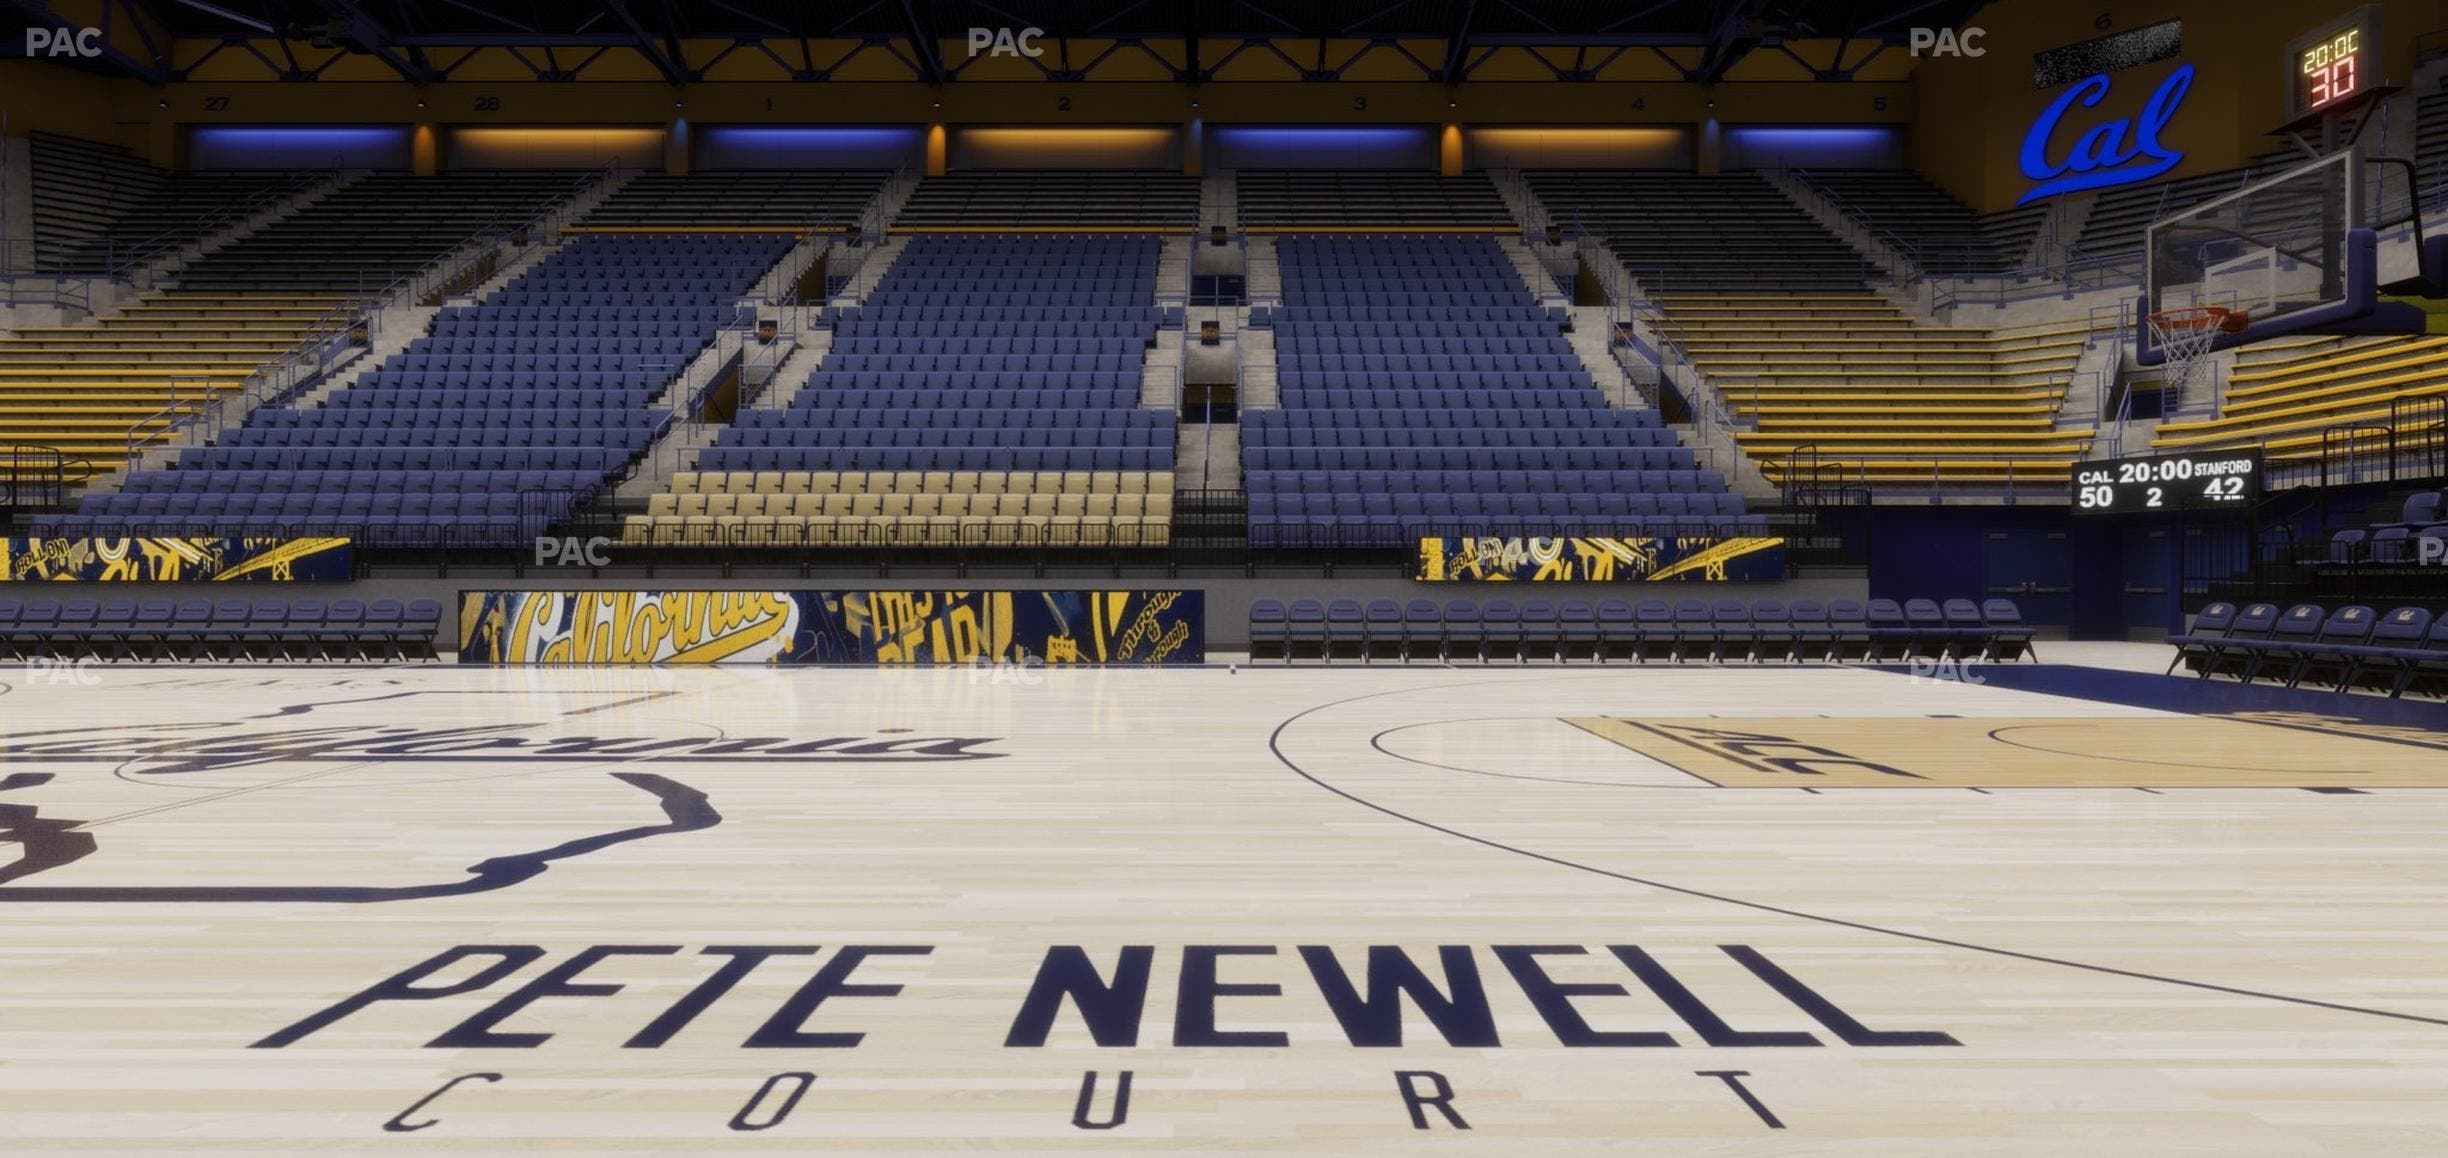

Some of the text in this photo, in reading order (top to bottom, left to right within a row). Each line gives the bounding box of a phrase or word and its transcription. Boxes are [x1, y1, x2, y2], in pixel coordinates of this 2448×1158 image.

[2310, 55, 2356, 108] 30
[204, 96, 230, 112] 27
[474, 96, 501, 112] 28
[765, 96, 774, 112] 1
[1057, 96, 1072, 112] 2
[1353, 96, 1368, 112] 3
[1631, 96, 1645, 111] 4
[1873, 96, 1887, 111] 5
[2017, 63, 2196, 207] Cal
[2078, 458, 2253, 485] CAL 20:00 STANFORD
[2079, 476, 2245, 508] 50 2 42
[245, 944, 1966, 1049] PETE NEWELL
[382, 1070, 1787, 1133] COURT
